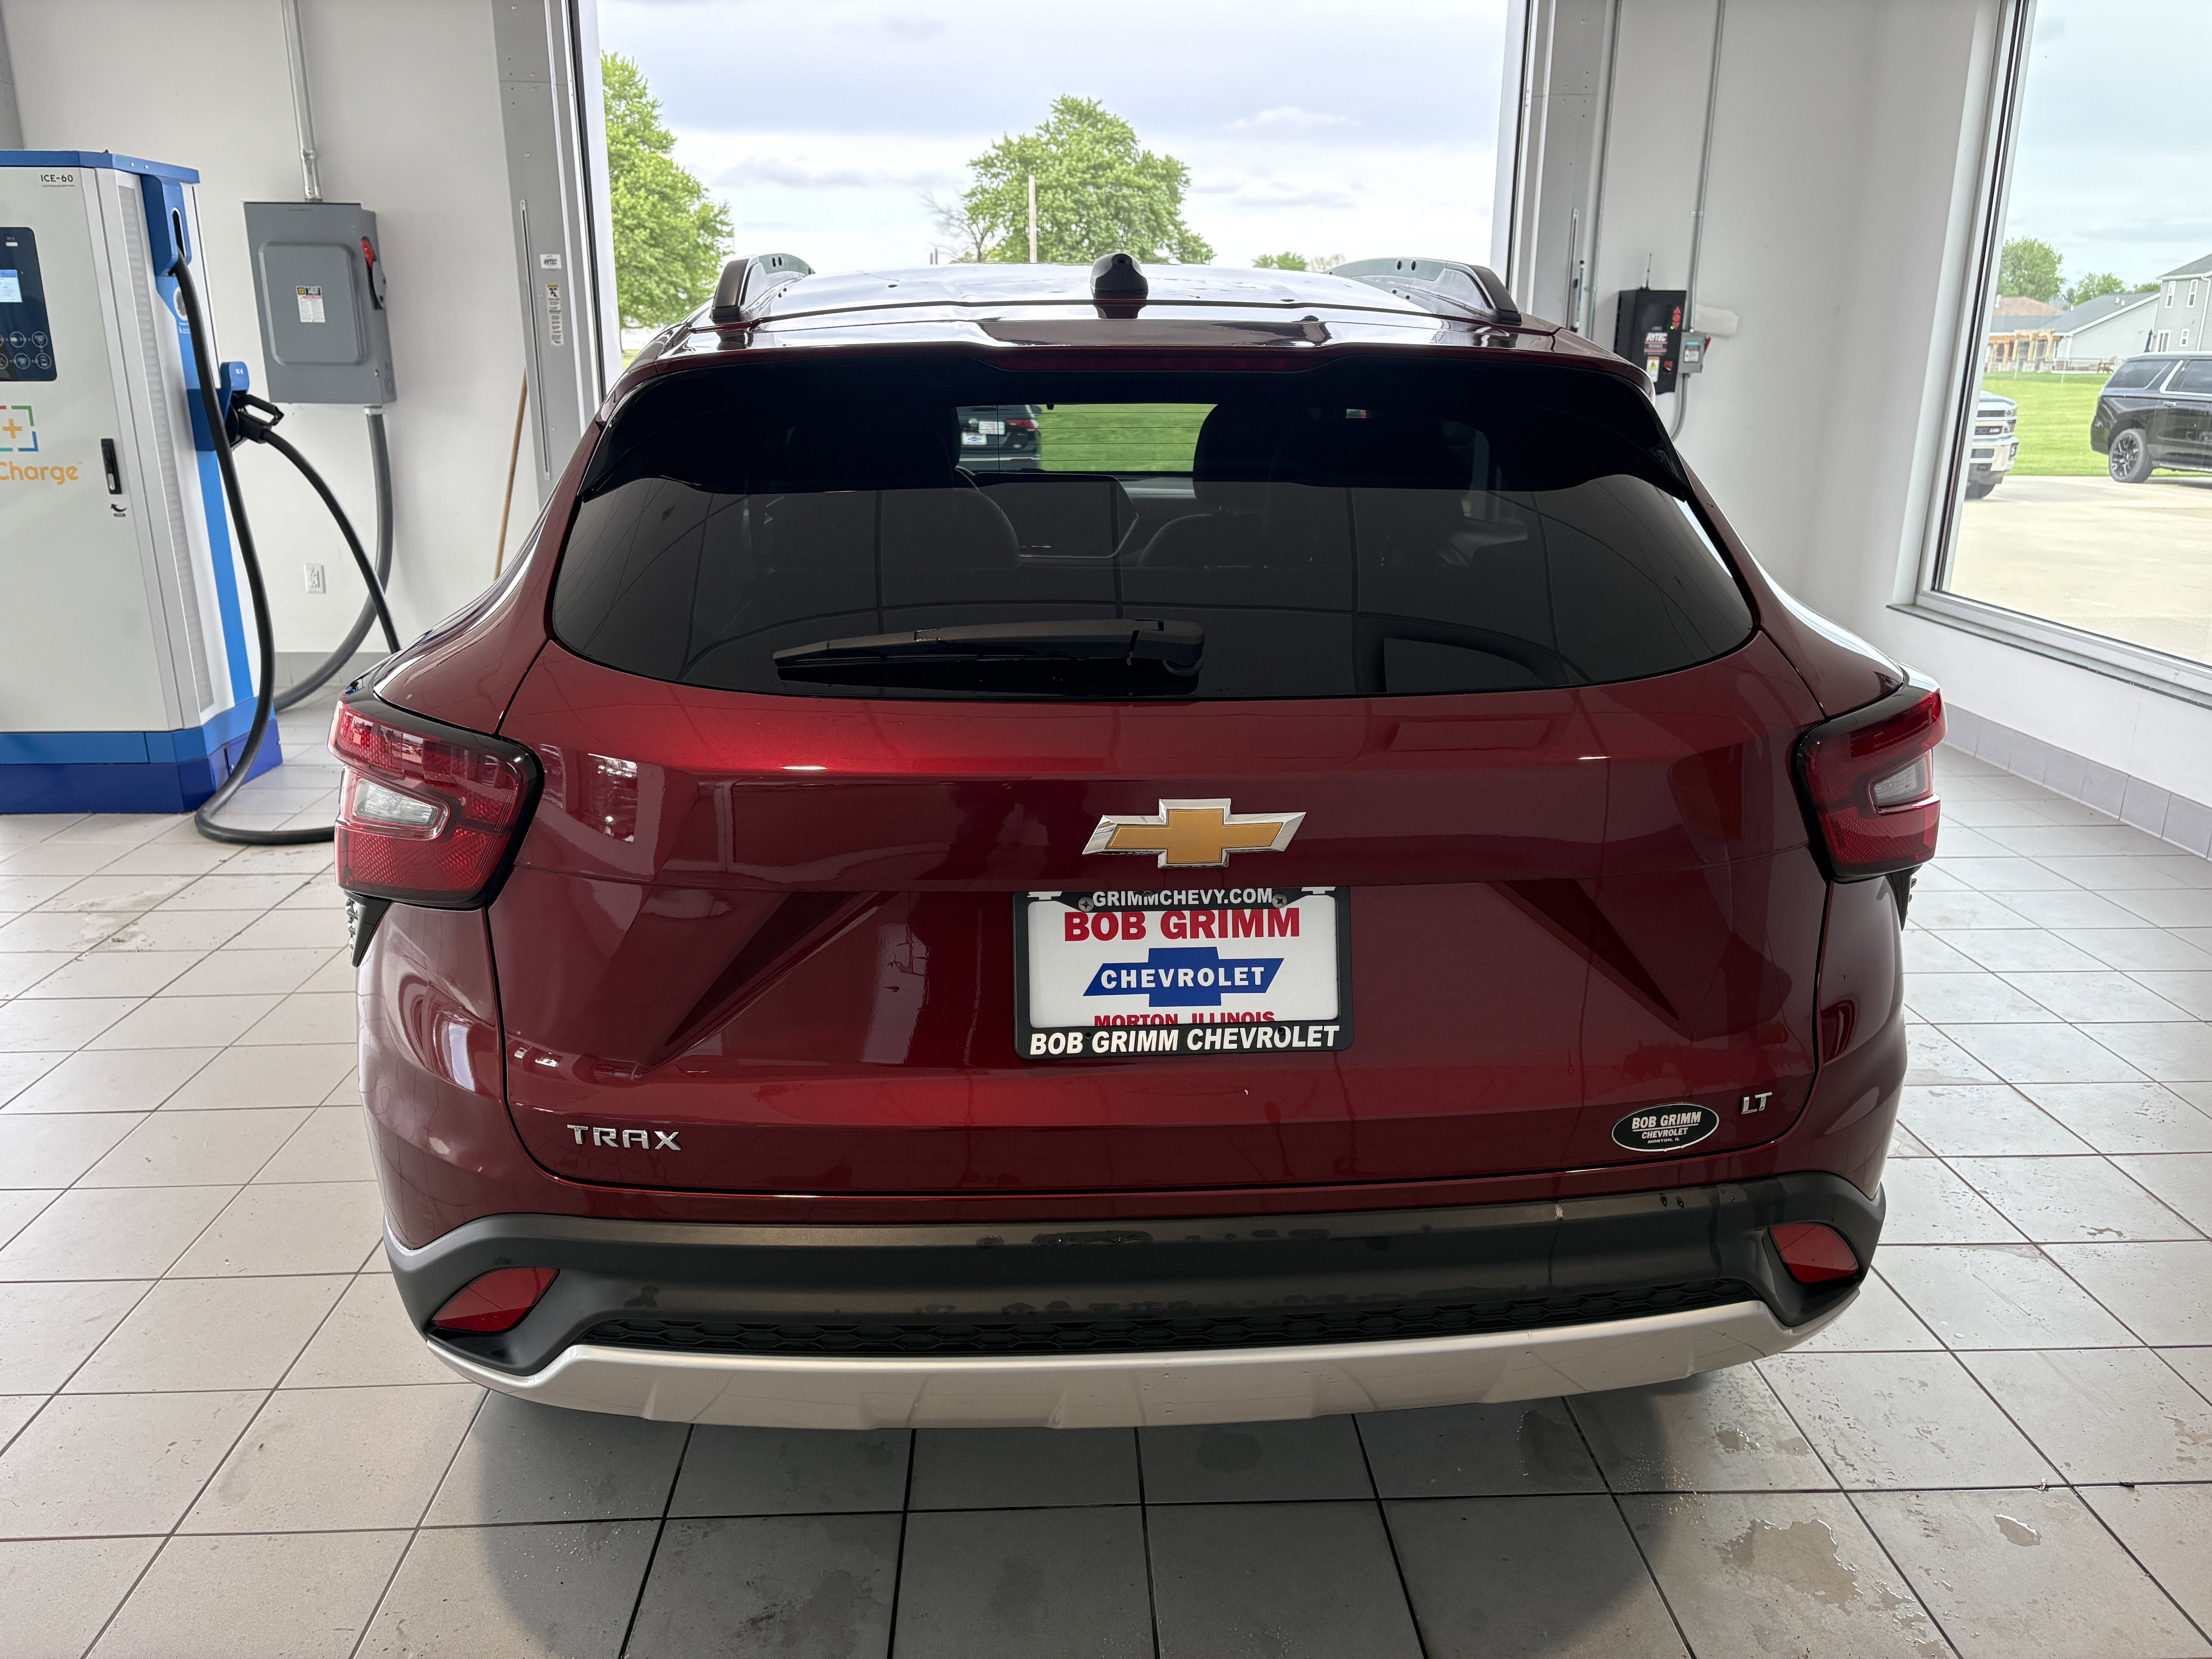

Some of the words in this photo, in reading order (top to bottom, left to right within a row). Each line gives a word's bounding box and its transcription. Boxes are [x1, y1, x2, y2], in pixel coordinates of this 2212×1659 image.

[40, 174, 73, 182] ICE-60
[1092, 888, 1272, 907] GRIMMCHEVY.COM
[1065, 911, 1146, 941] BOB
[1161, 908, 1300, 939] GRIMM
[1101, 967, 1264, 989] CHEVROLET
[1030, 1032, 1083, 1055] BOB
[1092, 1029, 1179, 1053] GRIMM
[1187, 1025, 1340, 1051] CHEVROLET
[1741, 1092, 1772, 1115] LT
[1632, 1116, 1657, 1129] BOB
[1660, 1111, 1702, 1127] GRIMM
[567, 1125, 682, 1151] TRAX
[1641, 1127, 1688, 1139] CHEVROLET
